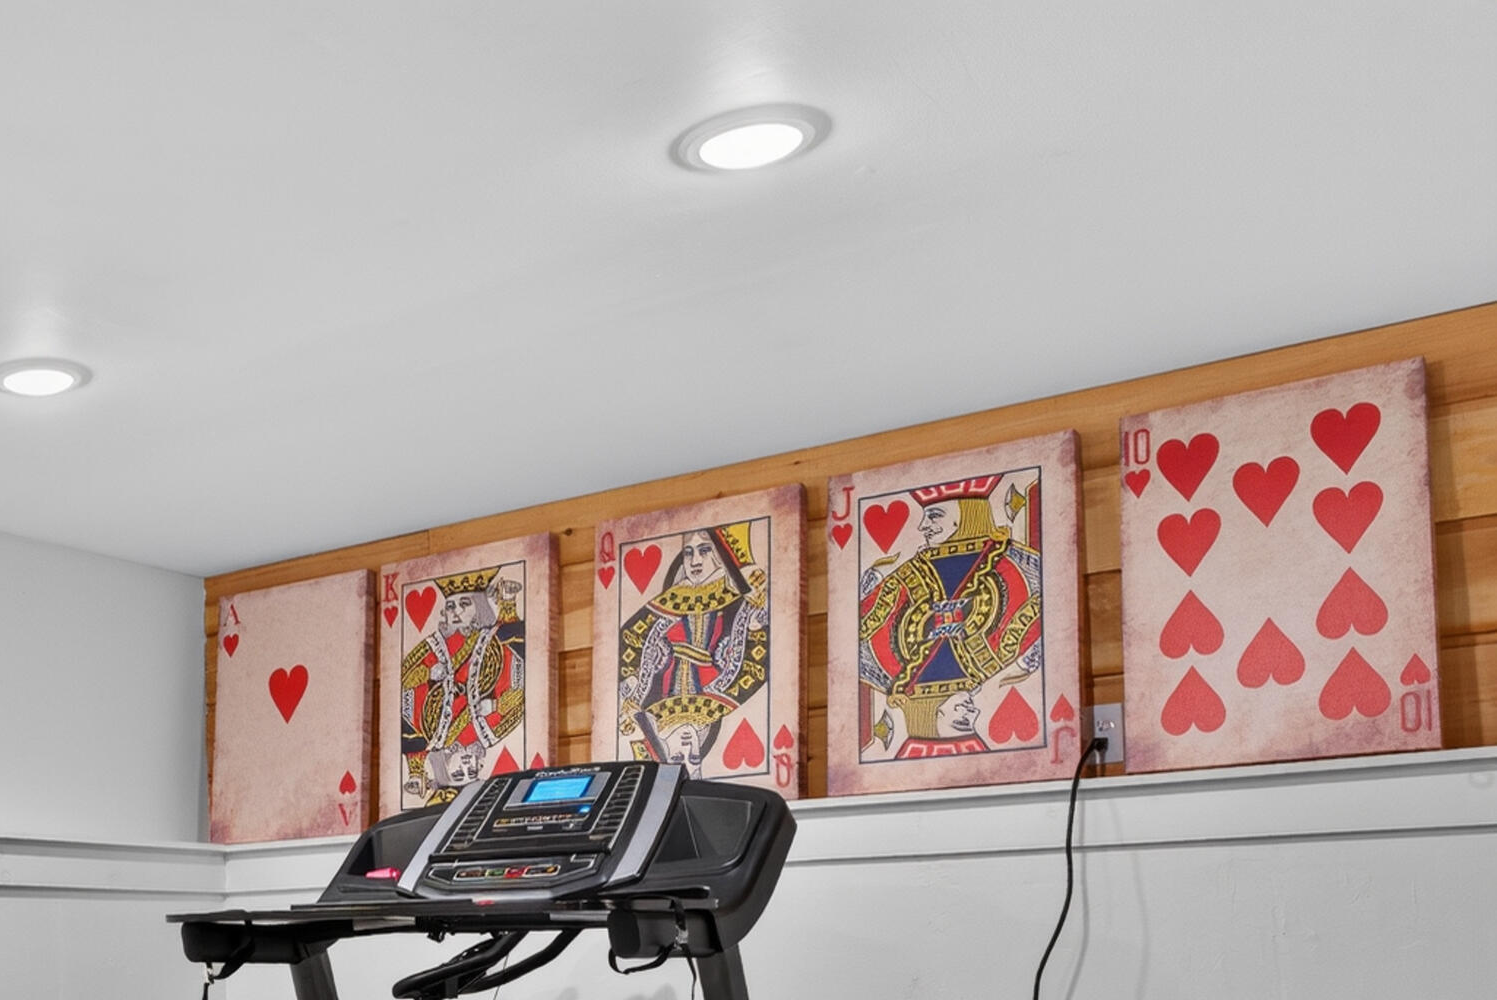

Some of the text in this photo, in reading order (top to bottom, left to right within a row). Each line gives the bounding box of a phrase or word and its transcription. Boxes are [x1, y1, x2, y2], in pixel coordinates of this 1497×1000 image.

[1124, 428, 1150, 467] 10
[832, 486, 855, 521] J
[600, 531, 615, 564] Q
[383, 572, 400, 602] K
[223, 604, 241, 627] A
[1400, 690, 1432, 732] 10
[1050, 726, 1077, 764] J
[773, 753, 792, 788] Q
[338, 801, 358, 826] A
